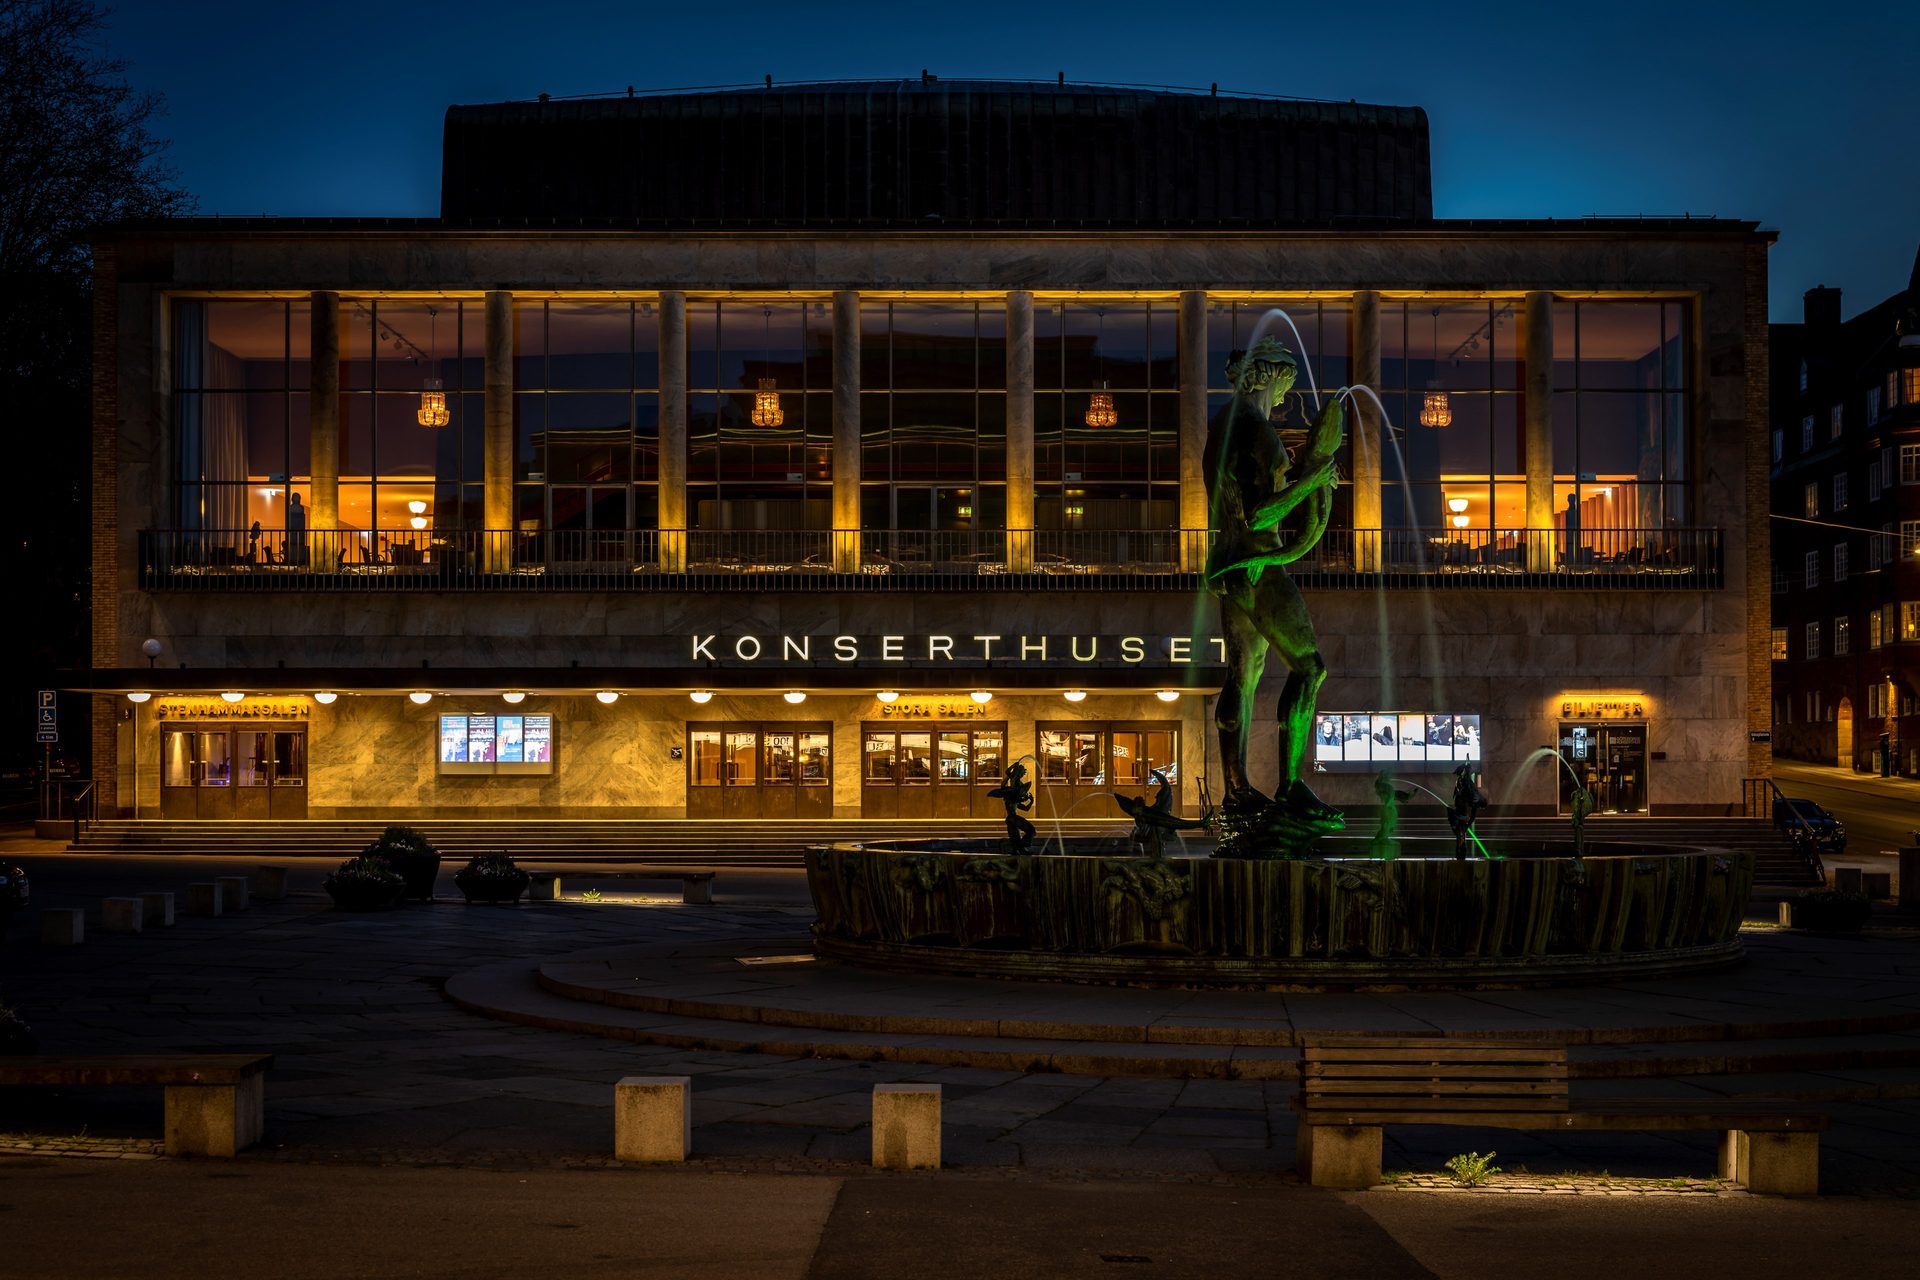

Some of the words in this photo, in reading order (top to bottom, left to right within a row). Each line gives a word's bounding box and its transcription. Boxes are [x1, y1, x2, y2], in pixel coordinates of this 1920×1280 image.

[692, 635, 1226, 663] KONSERTHUSET
[43, 693, 53, 706] P
[159, 704, 309, 717] STENHAMMARSALEN
[883, 704, 929, 714] STORA
[938, 704, 985, 714] SALEN
[1563, 702, 1642, 713] BILJETTER
